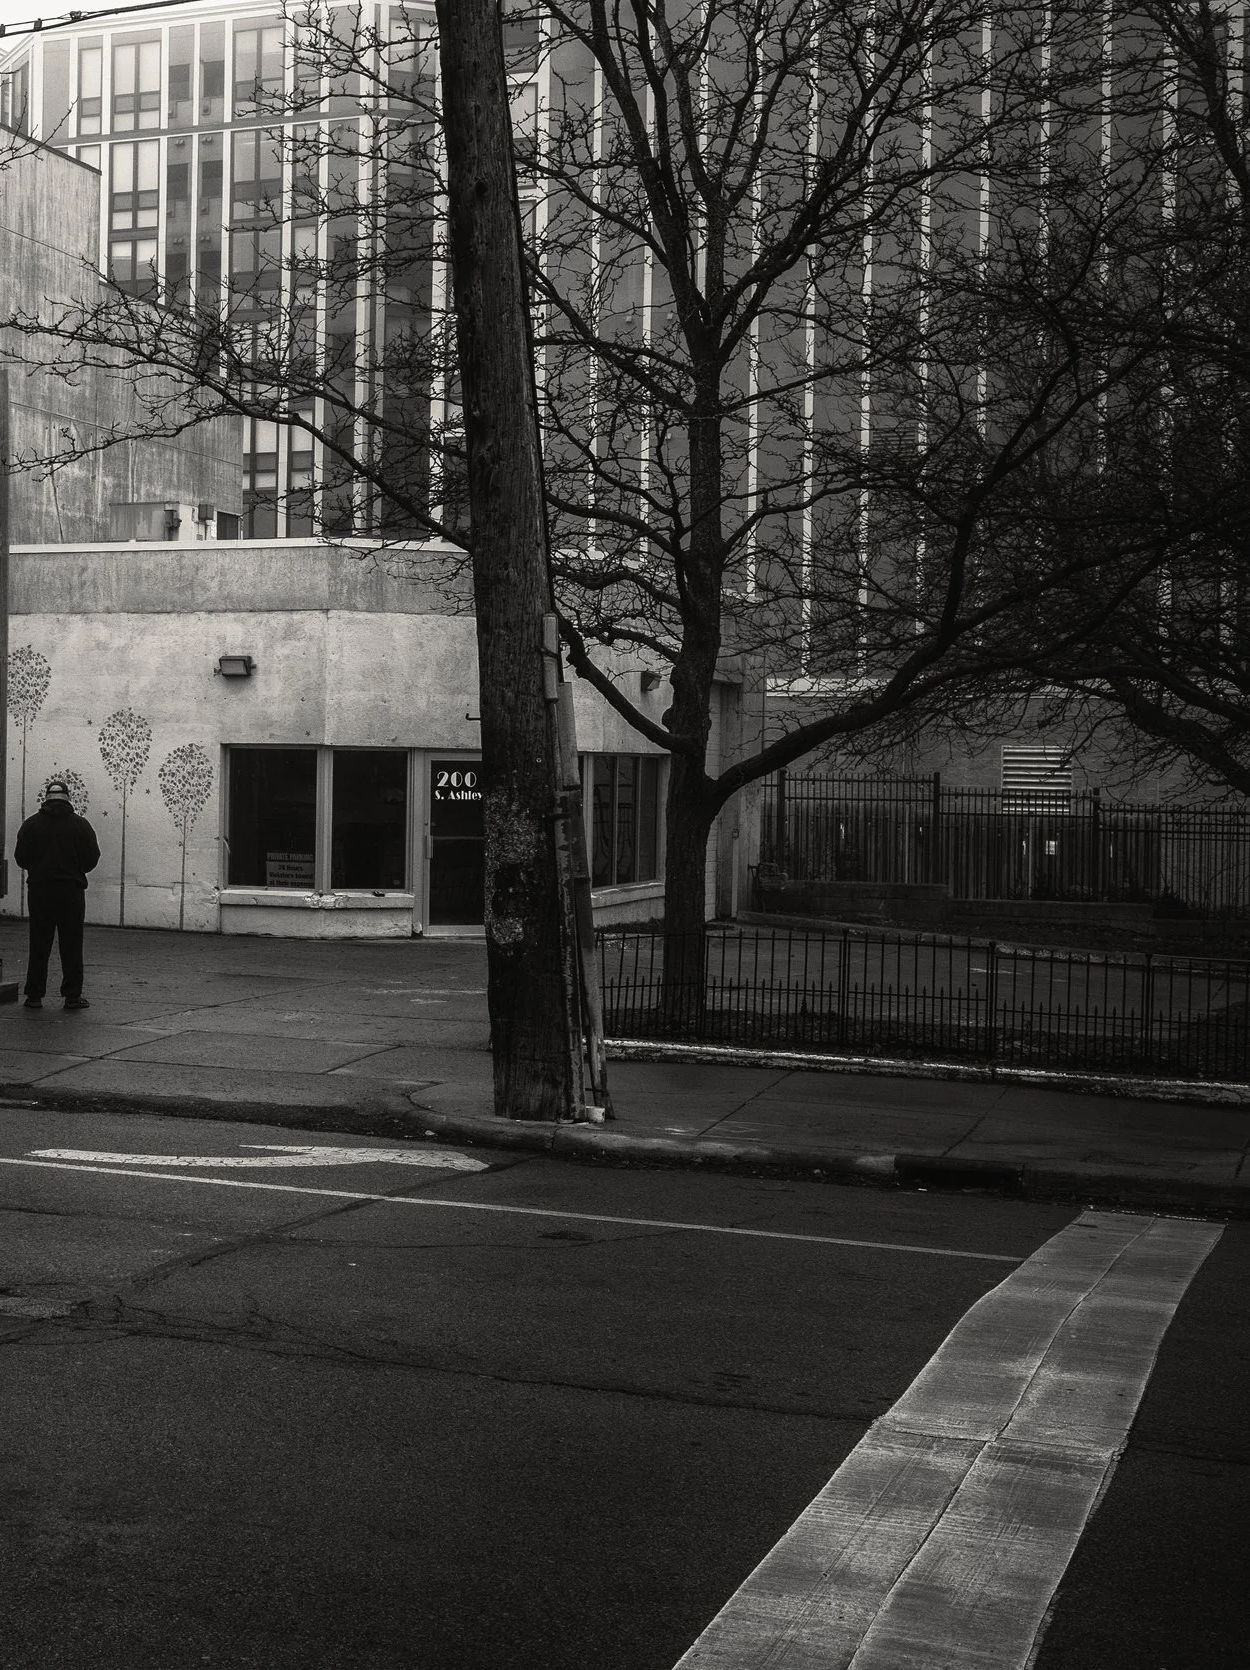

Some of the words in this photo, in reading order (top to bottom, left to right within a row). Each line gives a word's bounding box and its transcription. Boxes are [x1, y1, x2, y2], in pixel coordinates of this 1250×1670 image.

[436, 770, 477, 788] 200
[434, 789, 445, 801] S.
[447, 790, 483, 801] Ashley
